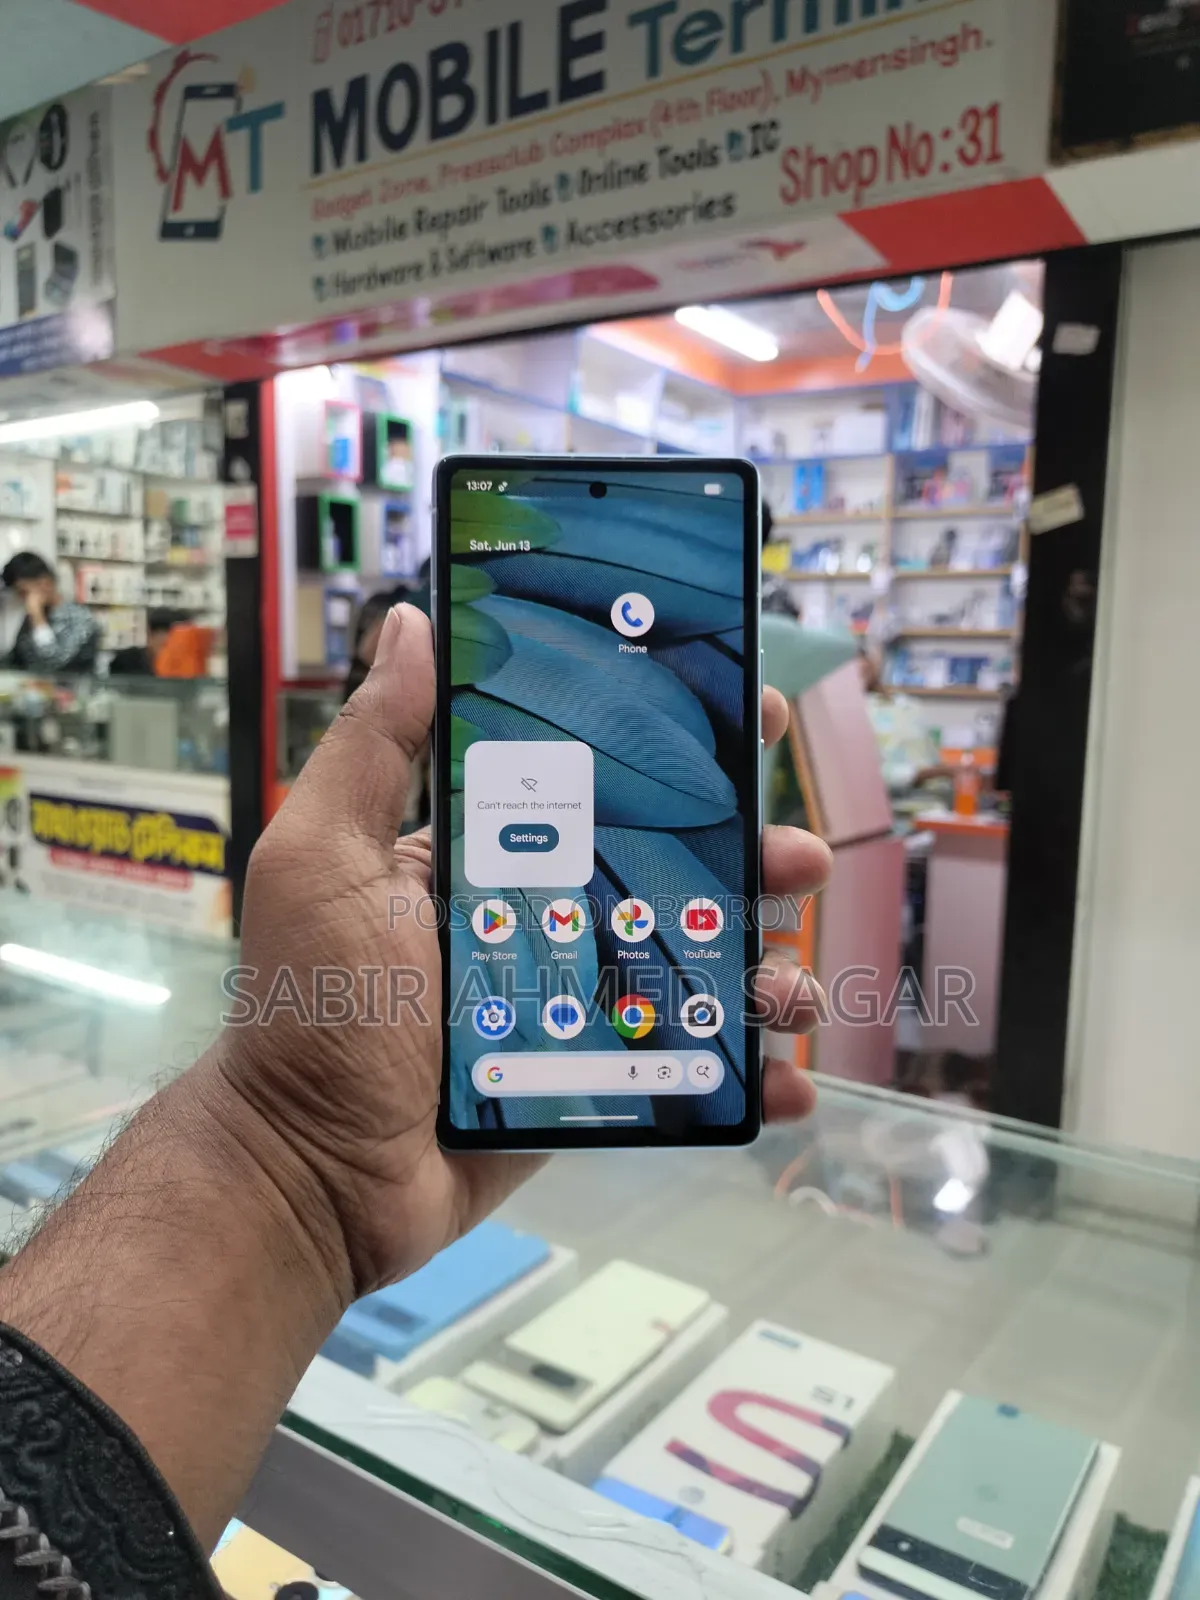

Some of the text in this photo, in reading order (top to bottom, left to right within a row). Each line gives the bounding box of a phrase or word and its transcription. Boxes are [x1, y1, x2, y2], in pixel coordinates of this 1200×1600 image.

[312, 0, 608, 177] MOBILE
[577, 137, 721, 196] Online Tools
[779, 143, 879, 208] Shop
[330, 178, 553, 254] Mobile Repair Tools
[566, 191, 737, 247] Accessories
[331, 261, 425, 297] Hardware
[444, 237, 536, 274] Software
[466, 480, 493, 492] 13:07
[469, 540, 531, 552] Sat, Jun 13
[618, 643, 648, 655] Phone
[477, 800, 582, 811] Can't reach the internet
[509, 832, 549, 845] Settings
[471, 951, 518, 962] Play Store
[550, 950, 578, 961] Gmail
[617, 950, 650, 961] Photos
[683, 949, 722, 960] YouTube
